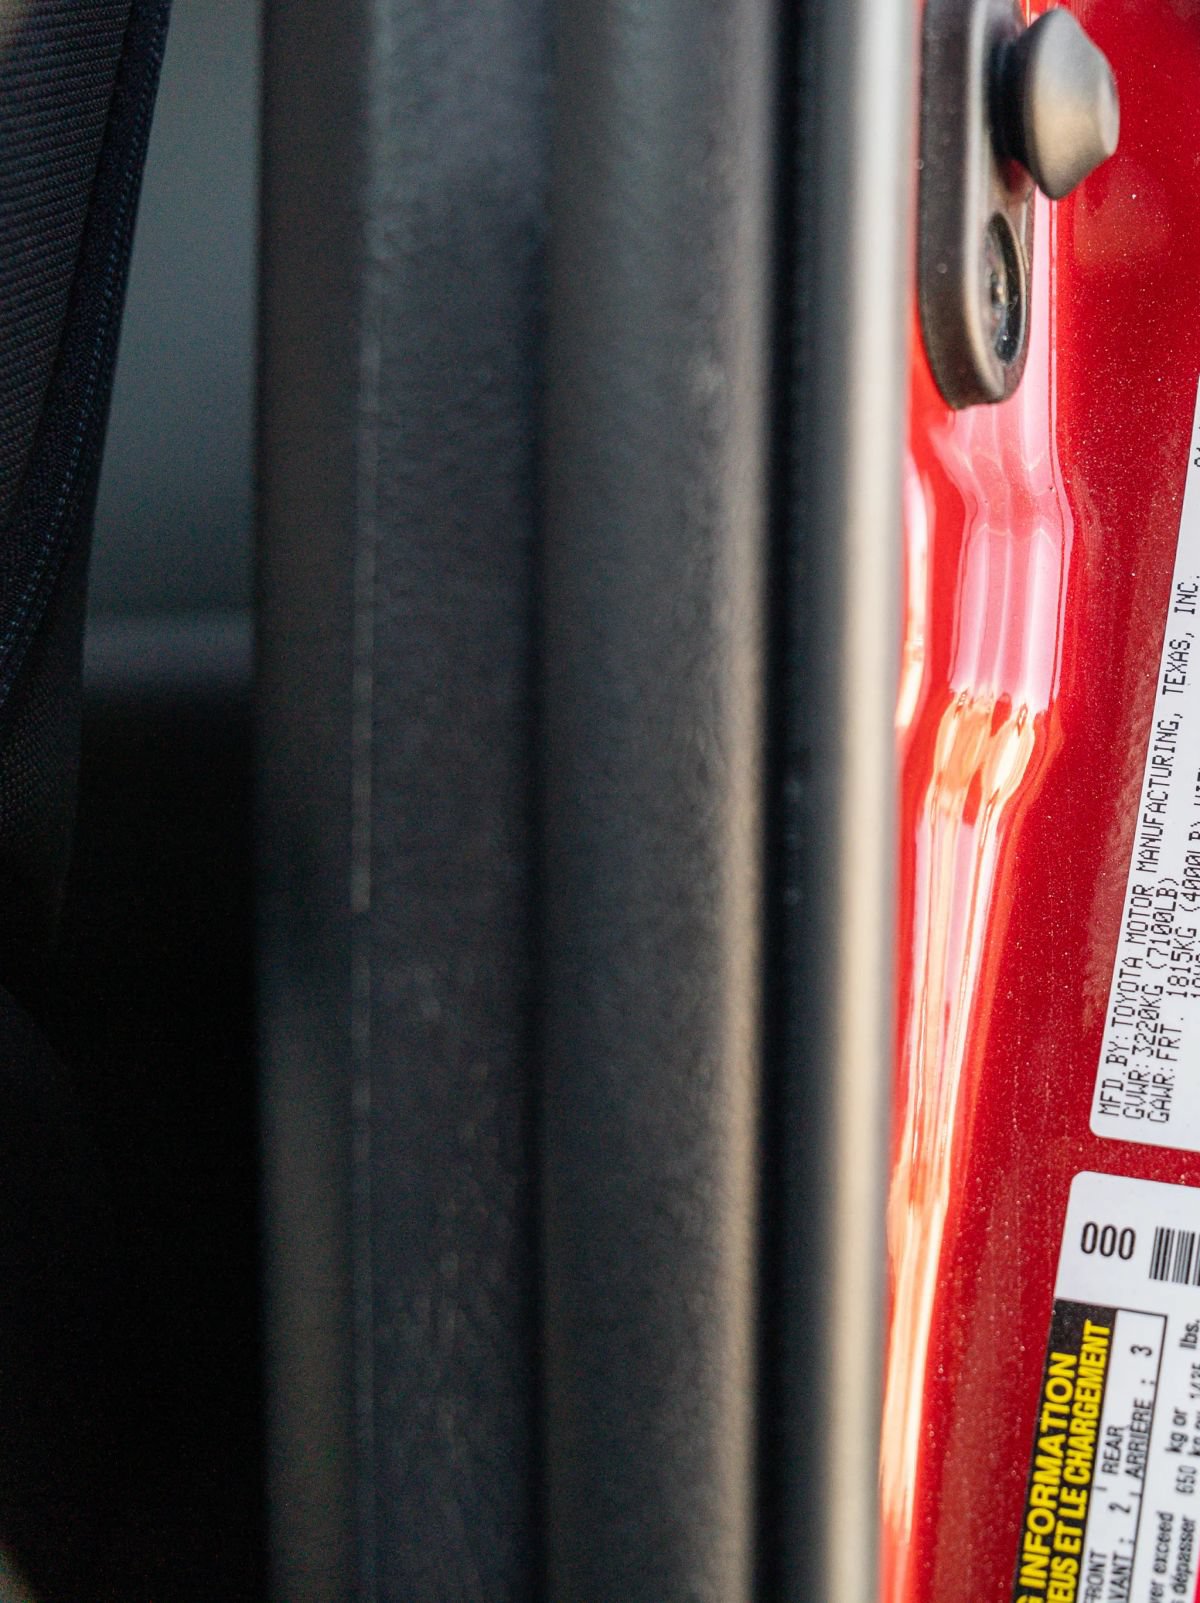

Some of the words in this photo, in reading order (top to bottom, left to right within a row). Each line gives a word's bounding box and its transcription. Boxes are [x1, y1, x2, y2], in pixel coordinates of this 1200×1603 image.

[1173, 575, 1200, 615] INC.
[1161, 632, 1195, 696] TEXAS,
[1135, 713, 1183, 874] MANUFACTURING,
[1124, 884, 1158, 945] MOTOR
[1145, 877, 1180, 970] (7100LB)
[1165, 926, 1197, 998] 1815KG
[1080, 1221, 1136, 1261] 000
[1129, 1345, 1153, 1357] 3
[1179, 1319, 1200, 1350] lbs.
[1063, 1319, 1110, 1484] CHARGEMENT
[1172, 1408, 1187, 1427] or
[1101, 1425, 1123, 1475] REAR
[1124, 1399, 1153, 1482] ARRIÈRE
[1165, 1432, 1189, 1454] kg
[1019, 1352, 1077, 1588] INFORMATION
[1175, 1466, 1197, 1495] 650
[1058, 1486, 1088, 1519] LE
[1108, 1502, 1131, 1515] 2
[1053, 1520, 1082, 1554] ET
[1152, 1511, 1174, 1575] exceed
[1171, 1516, 1195, 1595] dépasser
[1047, 1556, 1078, 1603] EUS
